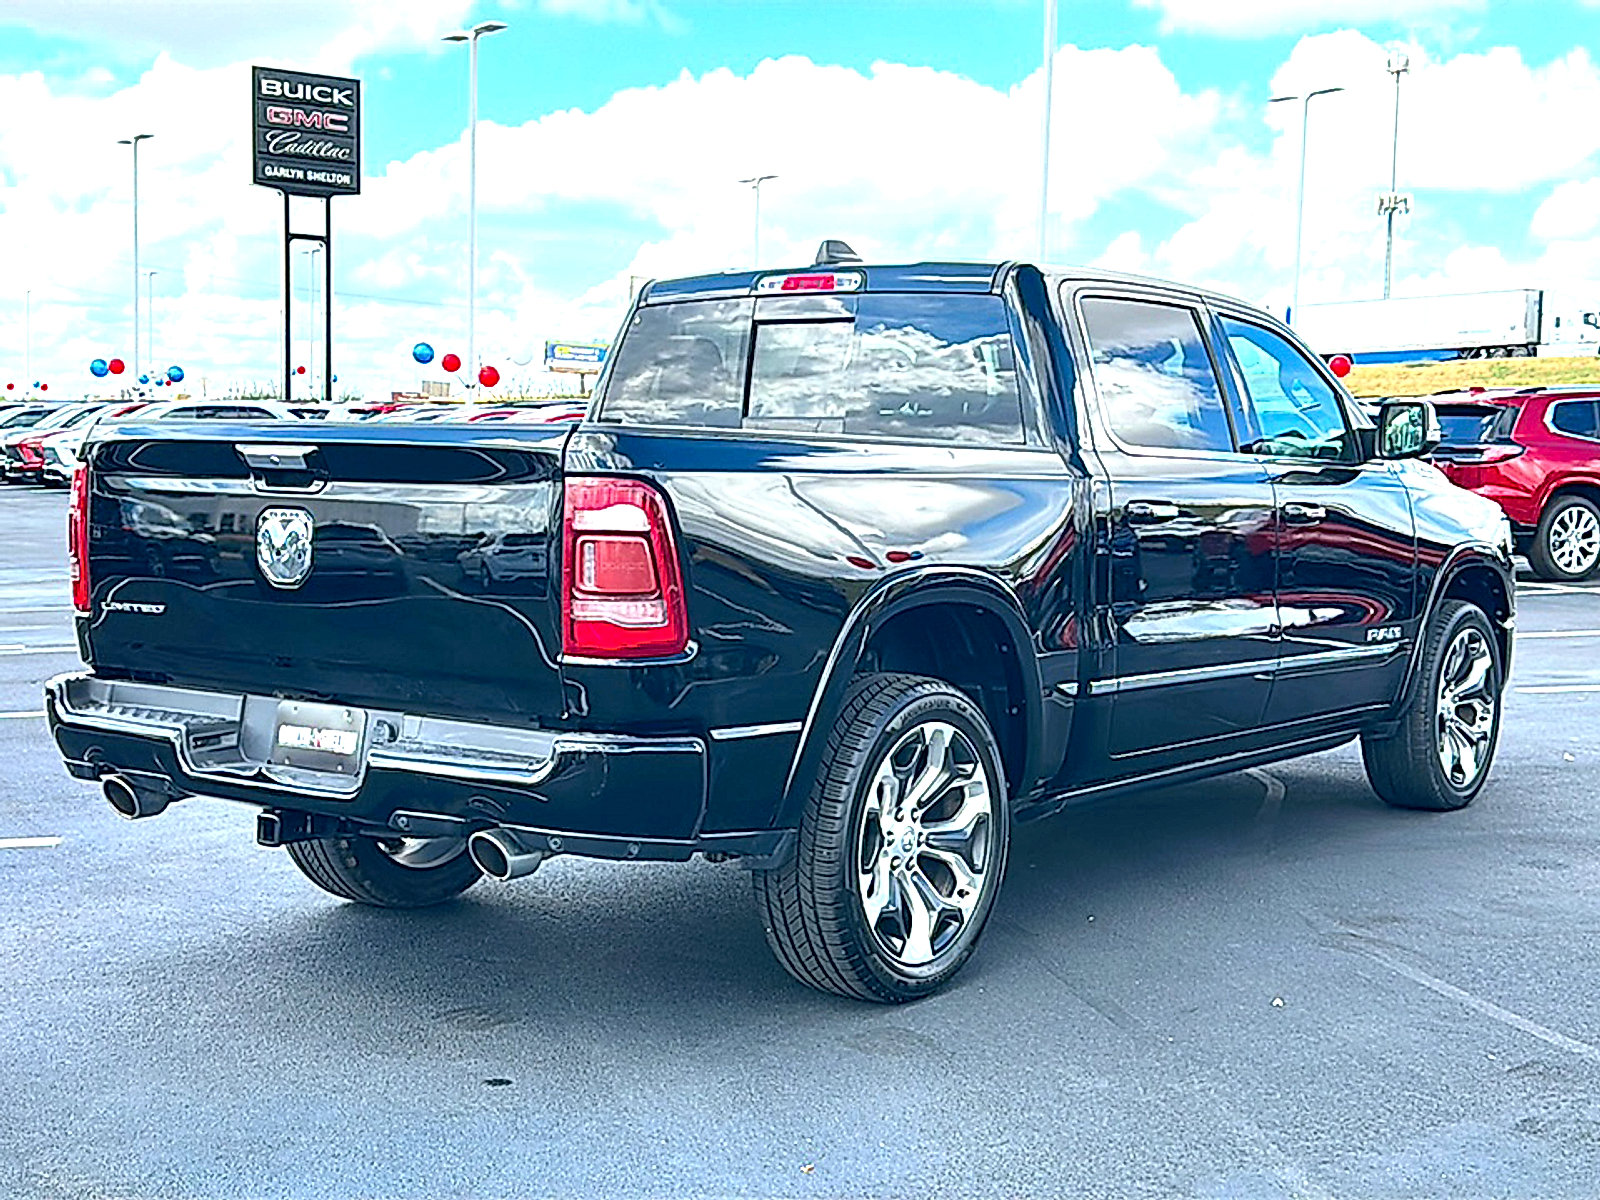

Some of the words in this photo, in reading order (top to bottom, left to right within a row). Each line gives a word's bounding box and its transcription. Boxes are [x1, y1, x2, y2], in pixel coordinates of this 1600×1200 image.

[260, 78, 354, 107] BUICK
[266, 105, 349, 132] GMC
[265, 129, 350, 160] Cadillac
[306, 170, 351, 185] SHELTON
